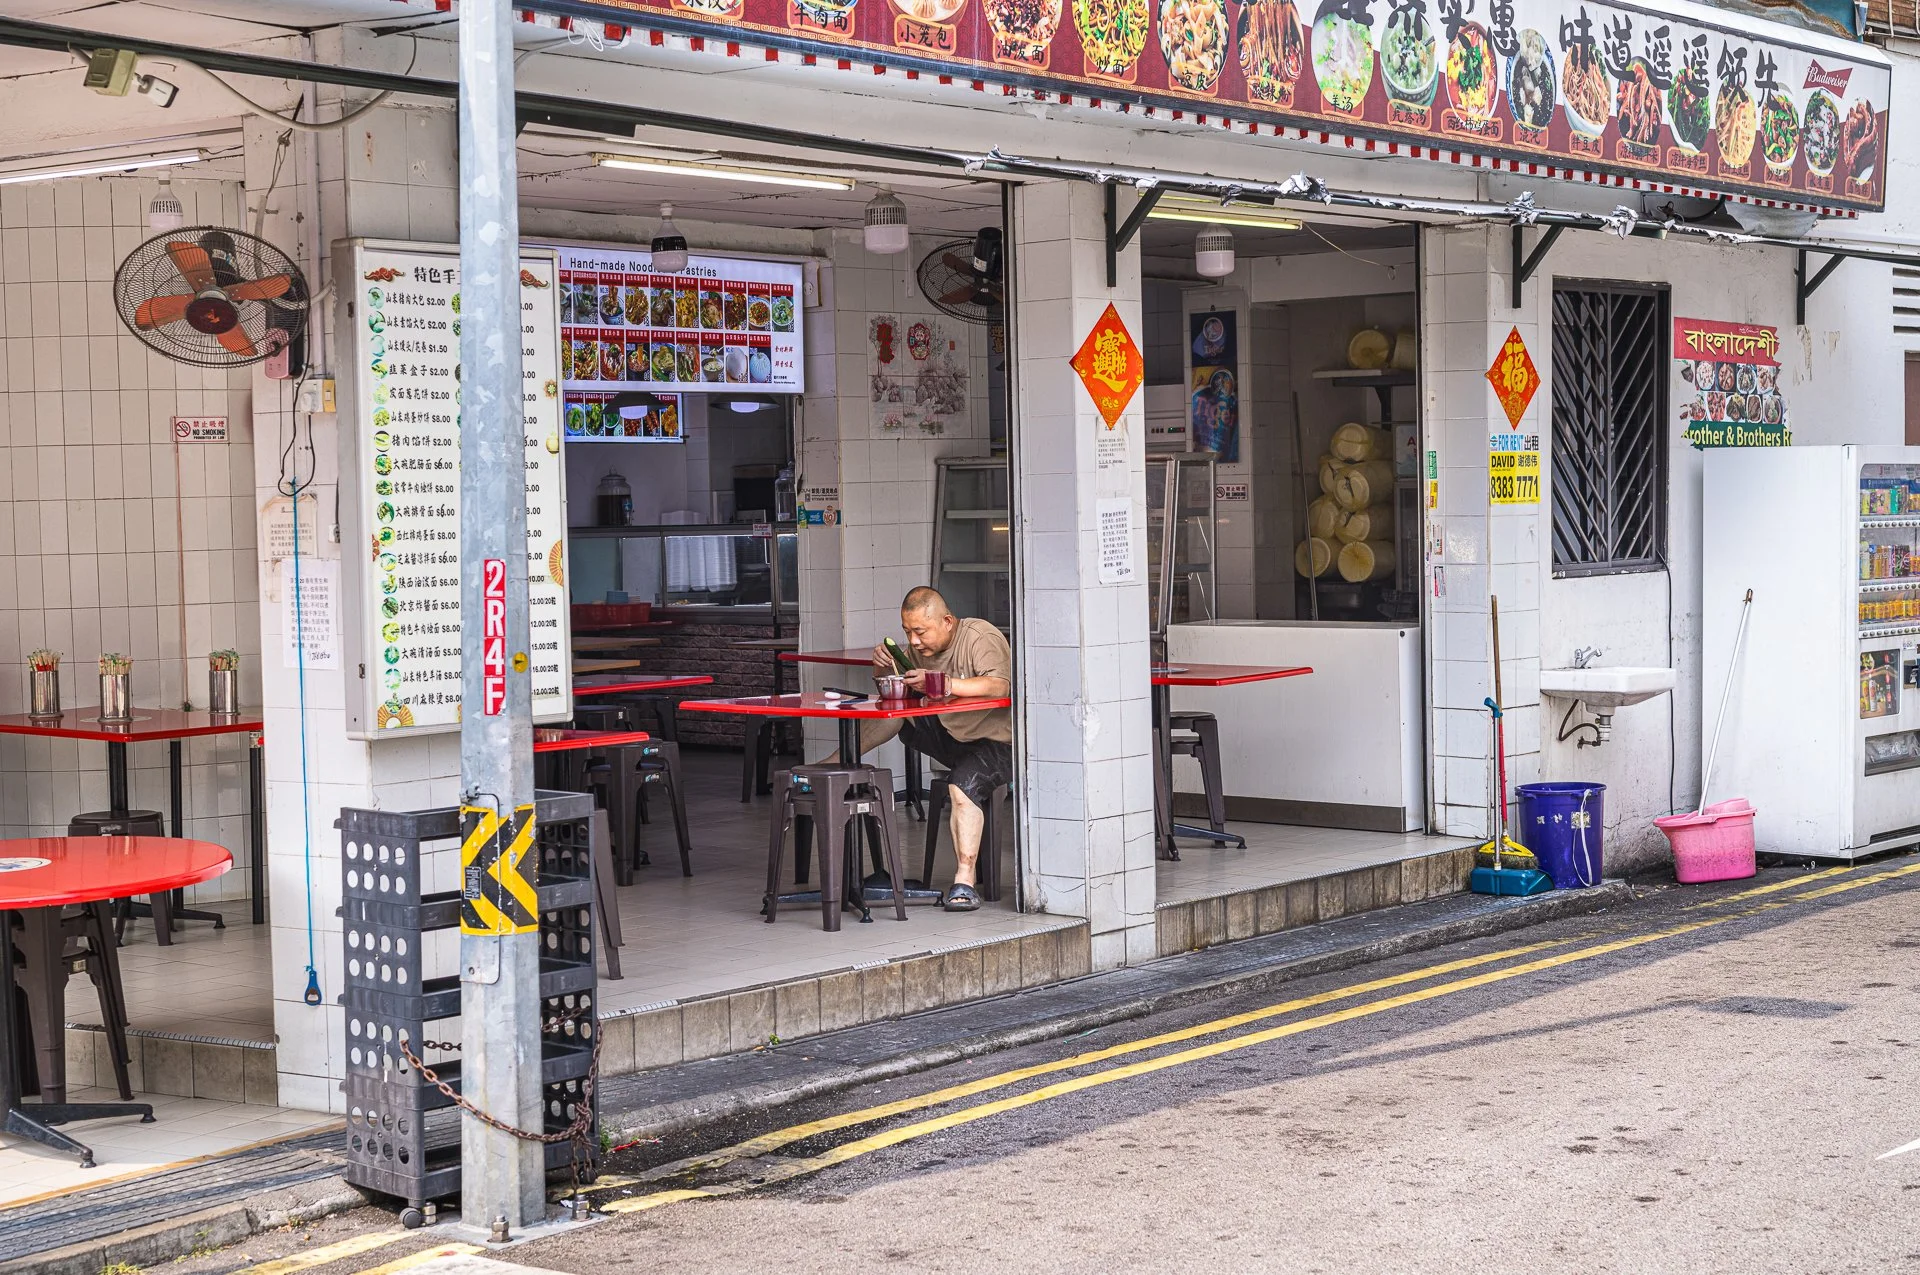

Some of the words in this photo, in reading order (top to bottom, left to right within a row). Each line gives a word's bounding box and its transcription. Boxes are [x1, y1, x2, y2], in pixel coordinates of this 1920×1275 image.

[794, 3, 848, 31] 牛肉面
[900, 22, 952, 51] 小笼包
[996, 39, 1045, 64] 油泼面
[1095, 54, 1125, 77] 炒面
[1807, 65, 1848, 89] Budweiser
[570, 257, 625, 270] Hand-made
[427, 297, 446, 306] $2.00
[428, 321, 447, 330] $2.00
[429, 344, 448, 353] $1.50
[430, 368, 449, 376] $2.00
[1501, 342, 1528, 393] 福
[431, 391, 450, 400] $2.00
[432, 415, 451, 423] $8.00
[1726, 425, 1735, 445] &
[1736, 426, 1781, 447] Brothers
[433, 438, 452, 447] $2.00
[1498, 434, 1509, 451] FOR
[1510, 434, 1524, 451] RENT
[1524, 435, 1539, 451] 出租
[1491, 455, 1515, 467] DAVID
[435, 485, 454, 493] $8.00
[1491, 475, 1514, 499] 8383
[1516, 475, 1538, 498] 7771
[437, 531, 456, 540] $8.00
[439, 578, 459, 587] $6.00
[440, 601, 460, 610] $6.00
[441, 624, 461, 633] $8.00
[485, 560, 506, 715] 2R4F
[443, 648, 462, 657] $5.00
